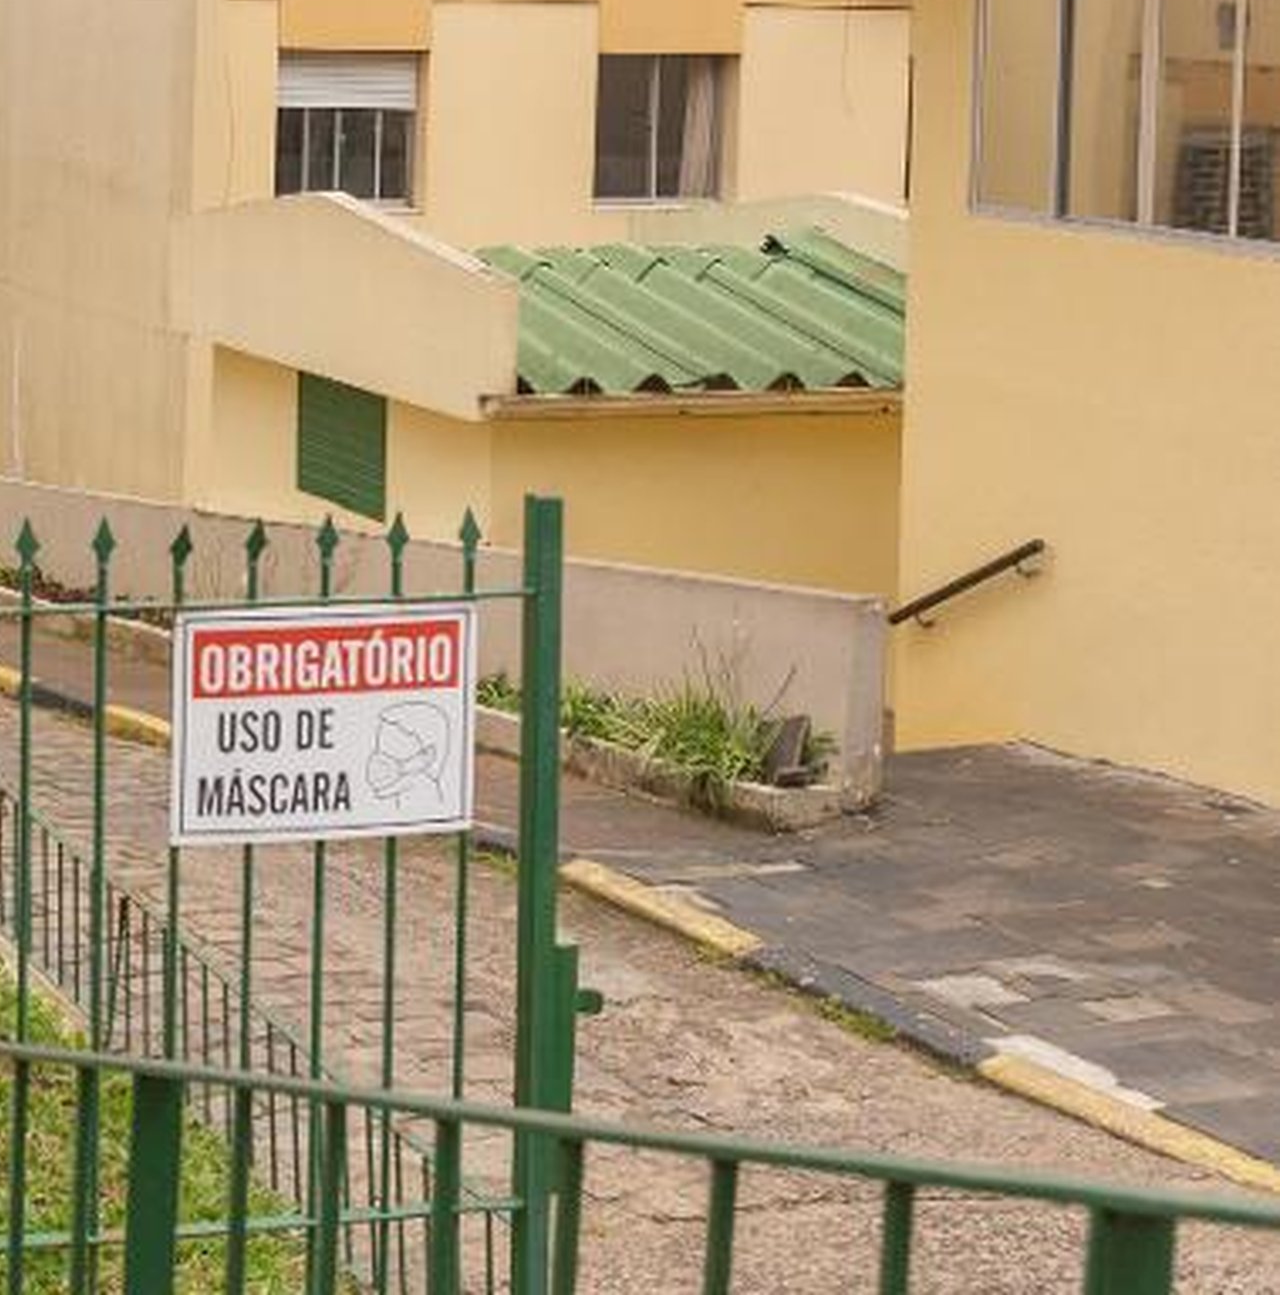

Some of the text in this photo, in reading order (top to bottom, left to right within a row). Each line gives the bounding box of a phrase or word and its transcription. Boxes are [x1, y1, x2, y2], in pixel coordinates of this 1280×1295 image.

[200, 630, 452, 693] OBRIGATÓRIO
[218, 708, 335, 754] USO DE
[197, 768, 352, 817] MÁSCARA
